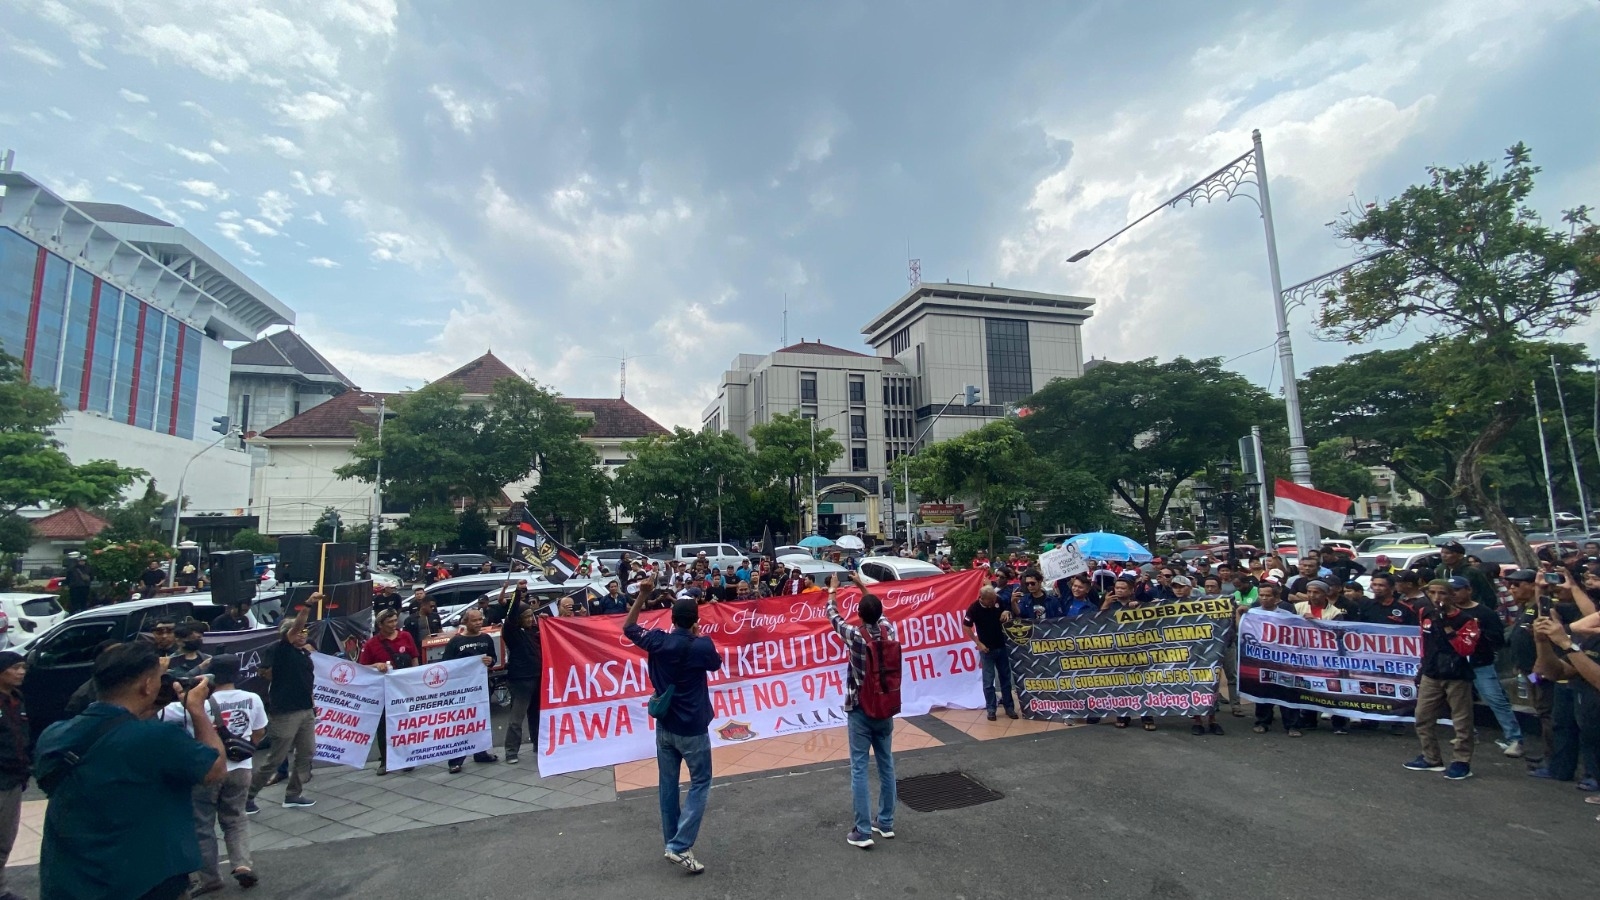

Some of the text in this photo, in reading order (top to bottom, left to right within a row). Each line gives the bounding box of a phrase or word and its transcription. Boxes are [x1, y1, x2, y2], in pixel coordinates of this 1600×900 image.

[723, 609, 785, 633] Harga
[790, 601, 828, 624] Diri
[842, 592, 860, 621] Ja
[881, 586, 935, 610] Tengah
[1119, 600, 1230, 621] ALDEBAREN
[1207, 612, 1232, 620] TEAM
[1030, 624, 1214, 655] HAPUS TARIF ILEGAL HEMAT
[1261, 621, 1422, 658] DRIVER ONLIN
[1061, 646, 1190, 671] BERLAKUKAN TARIF
[1246, 644, 1319, 667] KABUPATEN
[1322, 656, 1383, 675] KENDAL
[1025, 678, 1058, 692] SESUAI
[1059, 676, 1074, 690] SK
[1074, 672, 1127, 689] GUBERNUR
[1128, 671, 1143, 686] NO
[313, 693, 361, 711] ERGERAK..!!!
[317, 685, 339, 695] ONLINE
[340, 690, 379, 706] PURBALINGGA
[391, 685, 483, 706] DRIVER ONLINE PURBALINGGA
[545, 704, 633, 756] JAWA
[753, 679, 796, 711] NO.
[904, 653, 942, 681] TH.
[1030, 697, 1086, 713] Banyumas
[1087, 693, 1141, 712] Berjuang
[1143, 690, 1190, 710] Jateng
[321, 709, 360, 727] BUKAN
[397, 707, 477, 731] HAPUSKAN
[314, 724, 370, 746] APLIKATOR
[390, 719, 487, 748] TARIF MURAH
